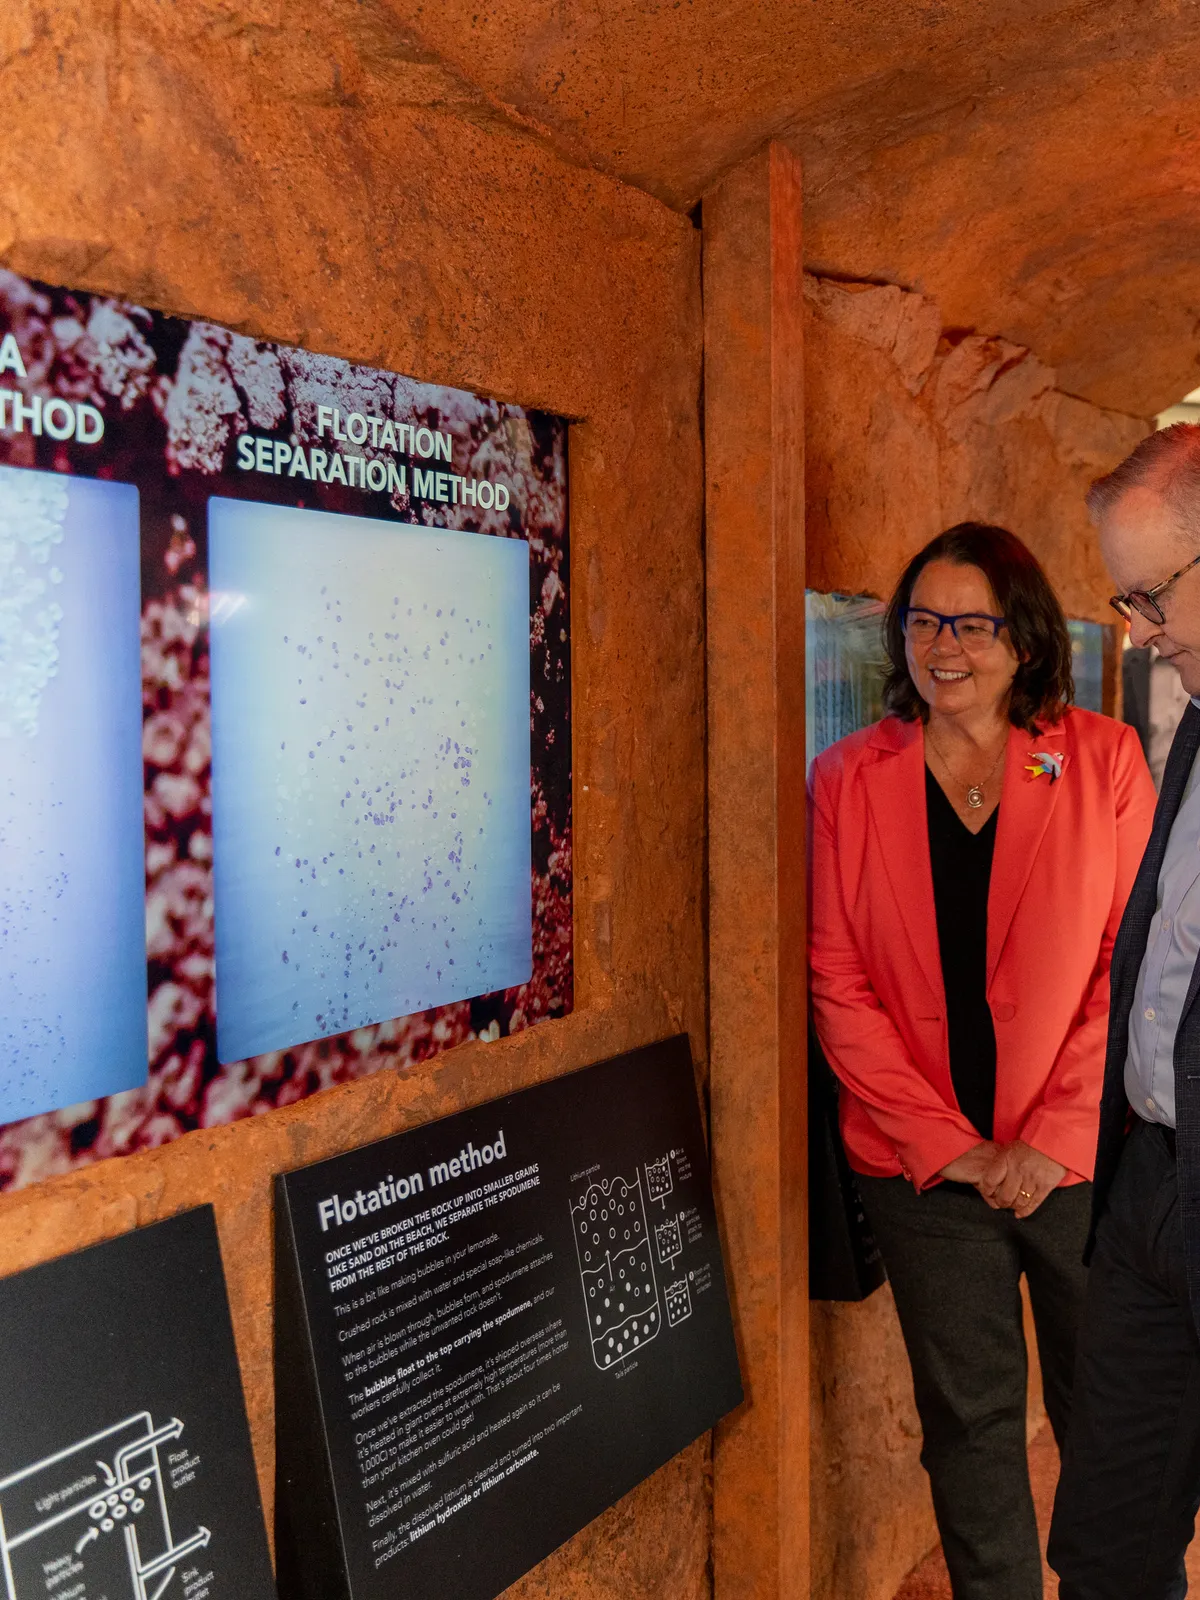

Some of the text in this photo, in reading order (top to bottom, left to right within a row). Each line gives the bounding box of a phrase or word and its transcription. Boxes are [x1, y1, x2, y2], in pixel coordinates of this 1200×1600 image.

[237, 434, 510, 511] SEPARATION METHOD
[318, 405, 452, 462] FLOTATION
[318, 1130, 506, 1232] Flotation method
[326, 1245, 352, 1263] ONCE
[381, 1218, 414, 1240] BROKEN
[415, 1210, 430, 1224] THE
[432, 1201, 453, 1217] ROCK
[454, 1196, 464, 1207] UP
[465, 1188, 482, 1202] INTO
[484, 1174, 514, 1194] SMALLER
[515, 1163, 539, 1180] GRAINS
[328, 1262, 348, 1278] LIKE
[348, 1251, 373, 1269] SAND
[374, 1244, 388, 1257] ON
[388, 1236, 405, 1250] THE
[435, 1217, 448, 1229] WE
[449, 1201, 483, 1224] SEPARATE
[484, 1195, 498, 1207] THE
[499, 1176, 540, 1201] SPODUMENE
[330, 1273, 357, 1292] FROM
[357, 1265, 375, 1279] THE
[376, 1255, 395, 1272] REST
[397, 1249, 408, 1262] OF
[409, 1242, 425, 1256] THE
[334, 1303, 351, 1316] This
[366, 1291, 376, 1302] bit
[377, 1286, 390, 1296] like
[391, 1274, 416, 1290] making
[417, 1260, 444, 1278] bubbles
[453, 1249, 466, 1263] your
[339, 1318, 371, 1342] Crushed
[372, 1311, 388, 1325] rock
[396, 1295, 417, 1313] mixed
[418, 1289, 432, 1302] with
[434, 1280, 451, 1294] water
[453, 1271, 465, 1285] and
[466, 1260, 487, 1279] special
[488, 1249, 514, 1267] soap-like
[342, 1350, 365, 1366] When
[367, 1343, 376, 1354] air
[384, 1329, 406, 1345] blown
[437, 1299, 463, 1318] bubbles
[482, 1281, 494, 1294] and
[495, 1265, 529, 1288] spodumene
[530, 1252, 553, 1269] attaches
[349, 1393, 364, 1405] The
[365, 1375, 396, 1397] bubbles
[397, 1363, 415, 1379] float
[426, 1352, 438, 1363] the
[440, 1344, 452, 1355] top
[454, 1328, 482, 1348] carrying
[482, 1321, 494, 1331] the
[534, 1291, 544, 1304] and
[546, 1287, 554, 1297] our
[355, 1364, 368, 1376] the
[369, 1348, 398, 1369] bubbles
[399, 1337, 417, 1352] while
[418, 1332, 430, 1342] the
[431, 1311, 463, 1335] unwanted
[464, 1304, 478, 1318] rock
[355, 1428, 376, 1445] Once
[399, 1392, 432, 1419] extracted
[433, 1389, 444, 1399] the
[495, 1342, 519, 1363] shipped
[520, 1329, 545, 1348] overseas
[545, 1319, 562, 1333] where
[352, 1399, 380, 1420] workers
[382, 1381, 410, 1404] carefully
[412, 1368, 435, 1386] collect
[370, 1429, 396, 1452] heated
[405, 1415, 423, 1434] giant
[424, 1404, 443, 1420] ovens
[453, 1379, 483, 1402] extremely
[484, 1370, 498, 1383] high
[499, 1347, 537, 1375] temperatures
[555, 1330, 567, 1341] than
[362, 1473, 379, 1488] than
[380, 1462, 396, 1480] your
[398, 1446, 423, 1466] kitchen
[424, 1435, 441, 1450] oven
[442, 1420, 460, 1438] could
[398, 1522, 410, 1534] the
[412, 1496, 444, 1525] dissolved
[444, 1484, 466, 1503] lithium
[474, 1459, 498, 1483] cleaned
[500, 1451, 511, 1466] and
[512, 1437, 532, 1457] turned
[532, 1432, 543, 1443] into
[544, 1424, 555, 1435] two
[556, 1405, 582, 1427] important
[400, 1470, 422, 1491] mixed
[422, 1461, 437, 1476] with
[438, 1447, 461, 1467] sulfuric
[462, 1435, 476, 1451] acid
[477, 1426, 489, 1442] and
[490, 1413, 511, 1433] heated
[512, 1404, 528, 1419] again
[542, 1389, 552, 1399] can
[369, 1498, 403, 1527] dissolved
[410, 1520, 436, 1542] lithium
[437, 1494, 472, 1524] hydroxide
[482, 1472, 505, 1492] lithium
